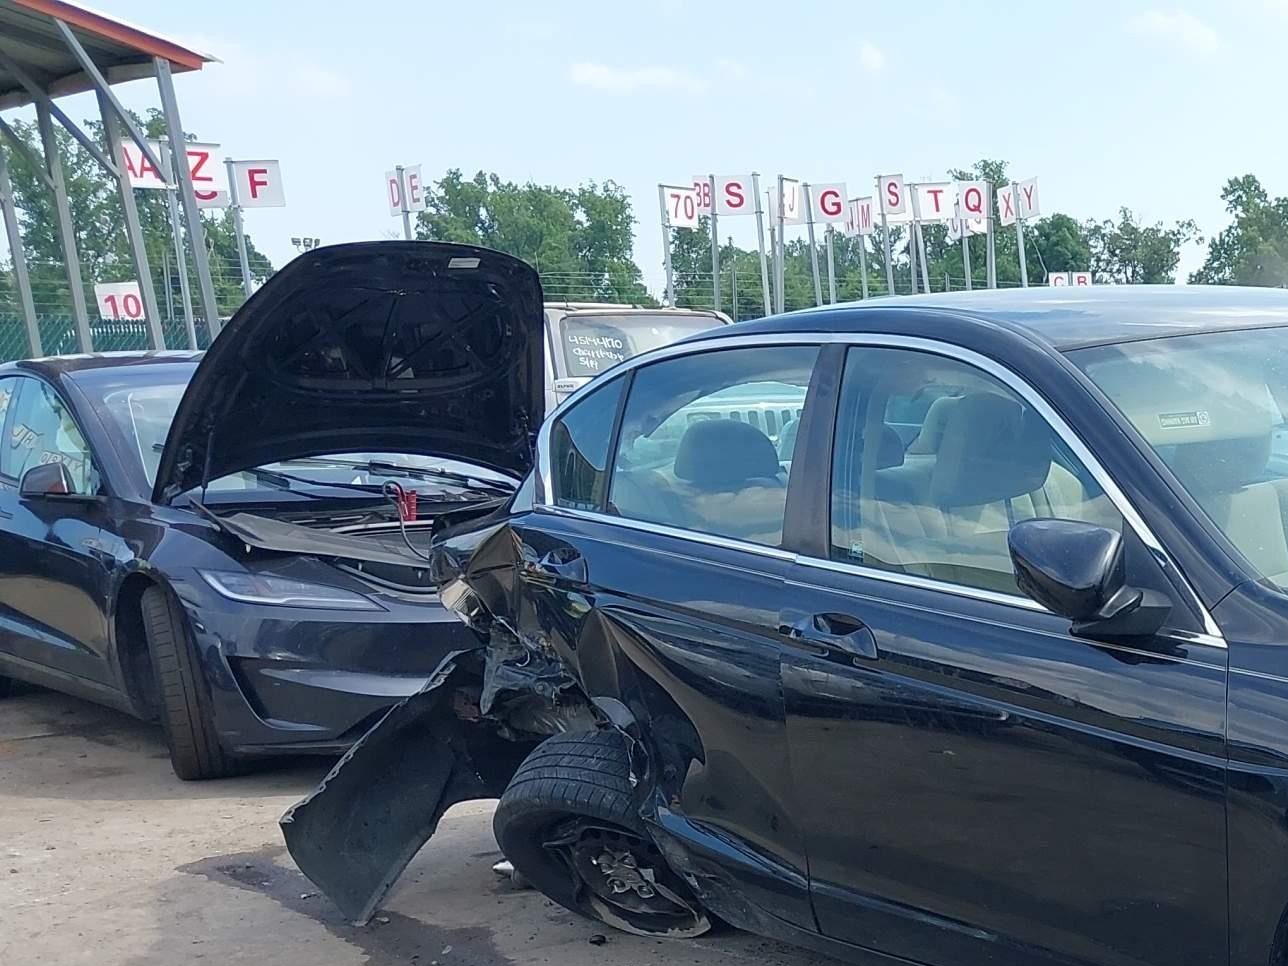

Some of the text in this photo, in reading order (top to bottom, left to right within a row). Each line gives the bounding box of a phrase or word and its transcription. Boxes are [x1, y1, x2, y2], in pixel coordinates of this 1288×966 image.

[186, 151, 214, 182] Z
[247, 168, 268, 199] F
[409, 174, 421, 204] E
[724, 182, 745, 208] S
[887, 182, 900, 207] S
[670, 193, 695, 220] 70
[820, 190, 842, 216] G
[926, 189, 944, 213] T
[964, 187, 982, 214] Q
[1002, 192, 1014, 218] X
[1023, 184, 1033, 211] Y
[860, 203, 871, 229] M
[104, 293, 142, 320] 10
